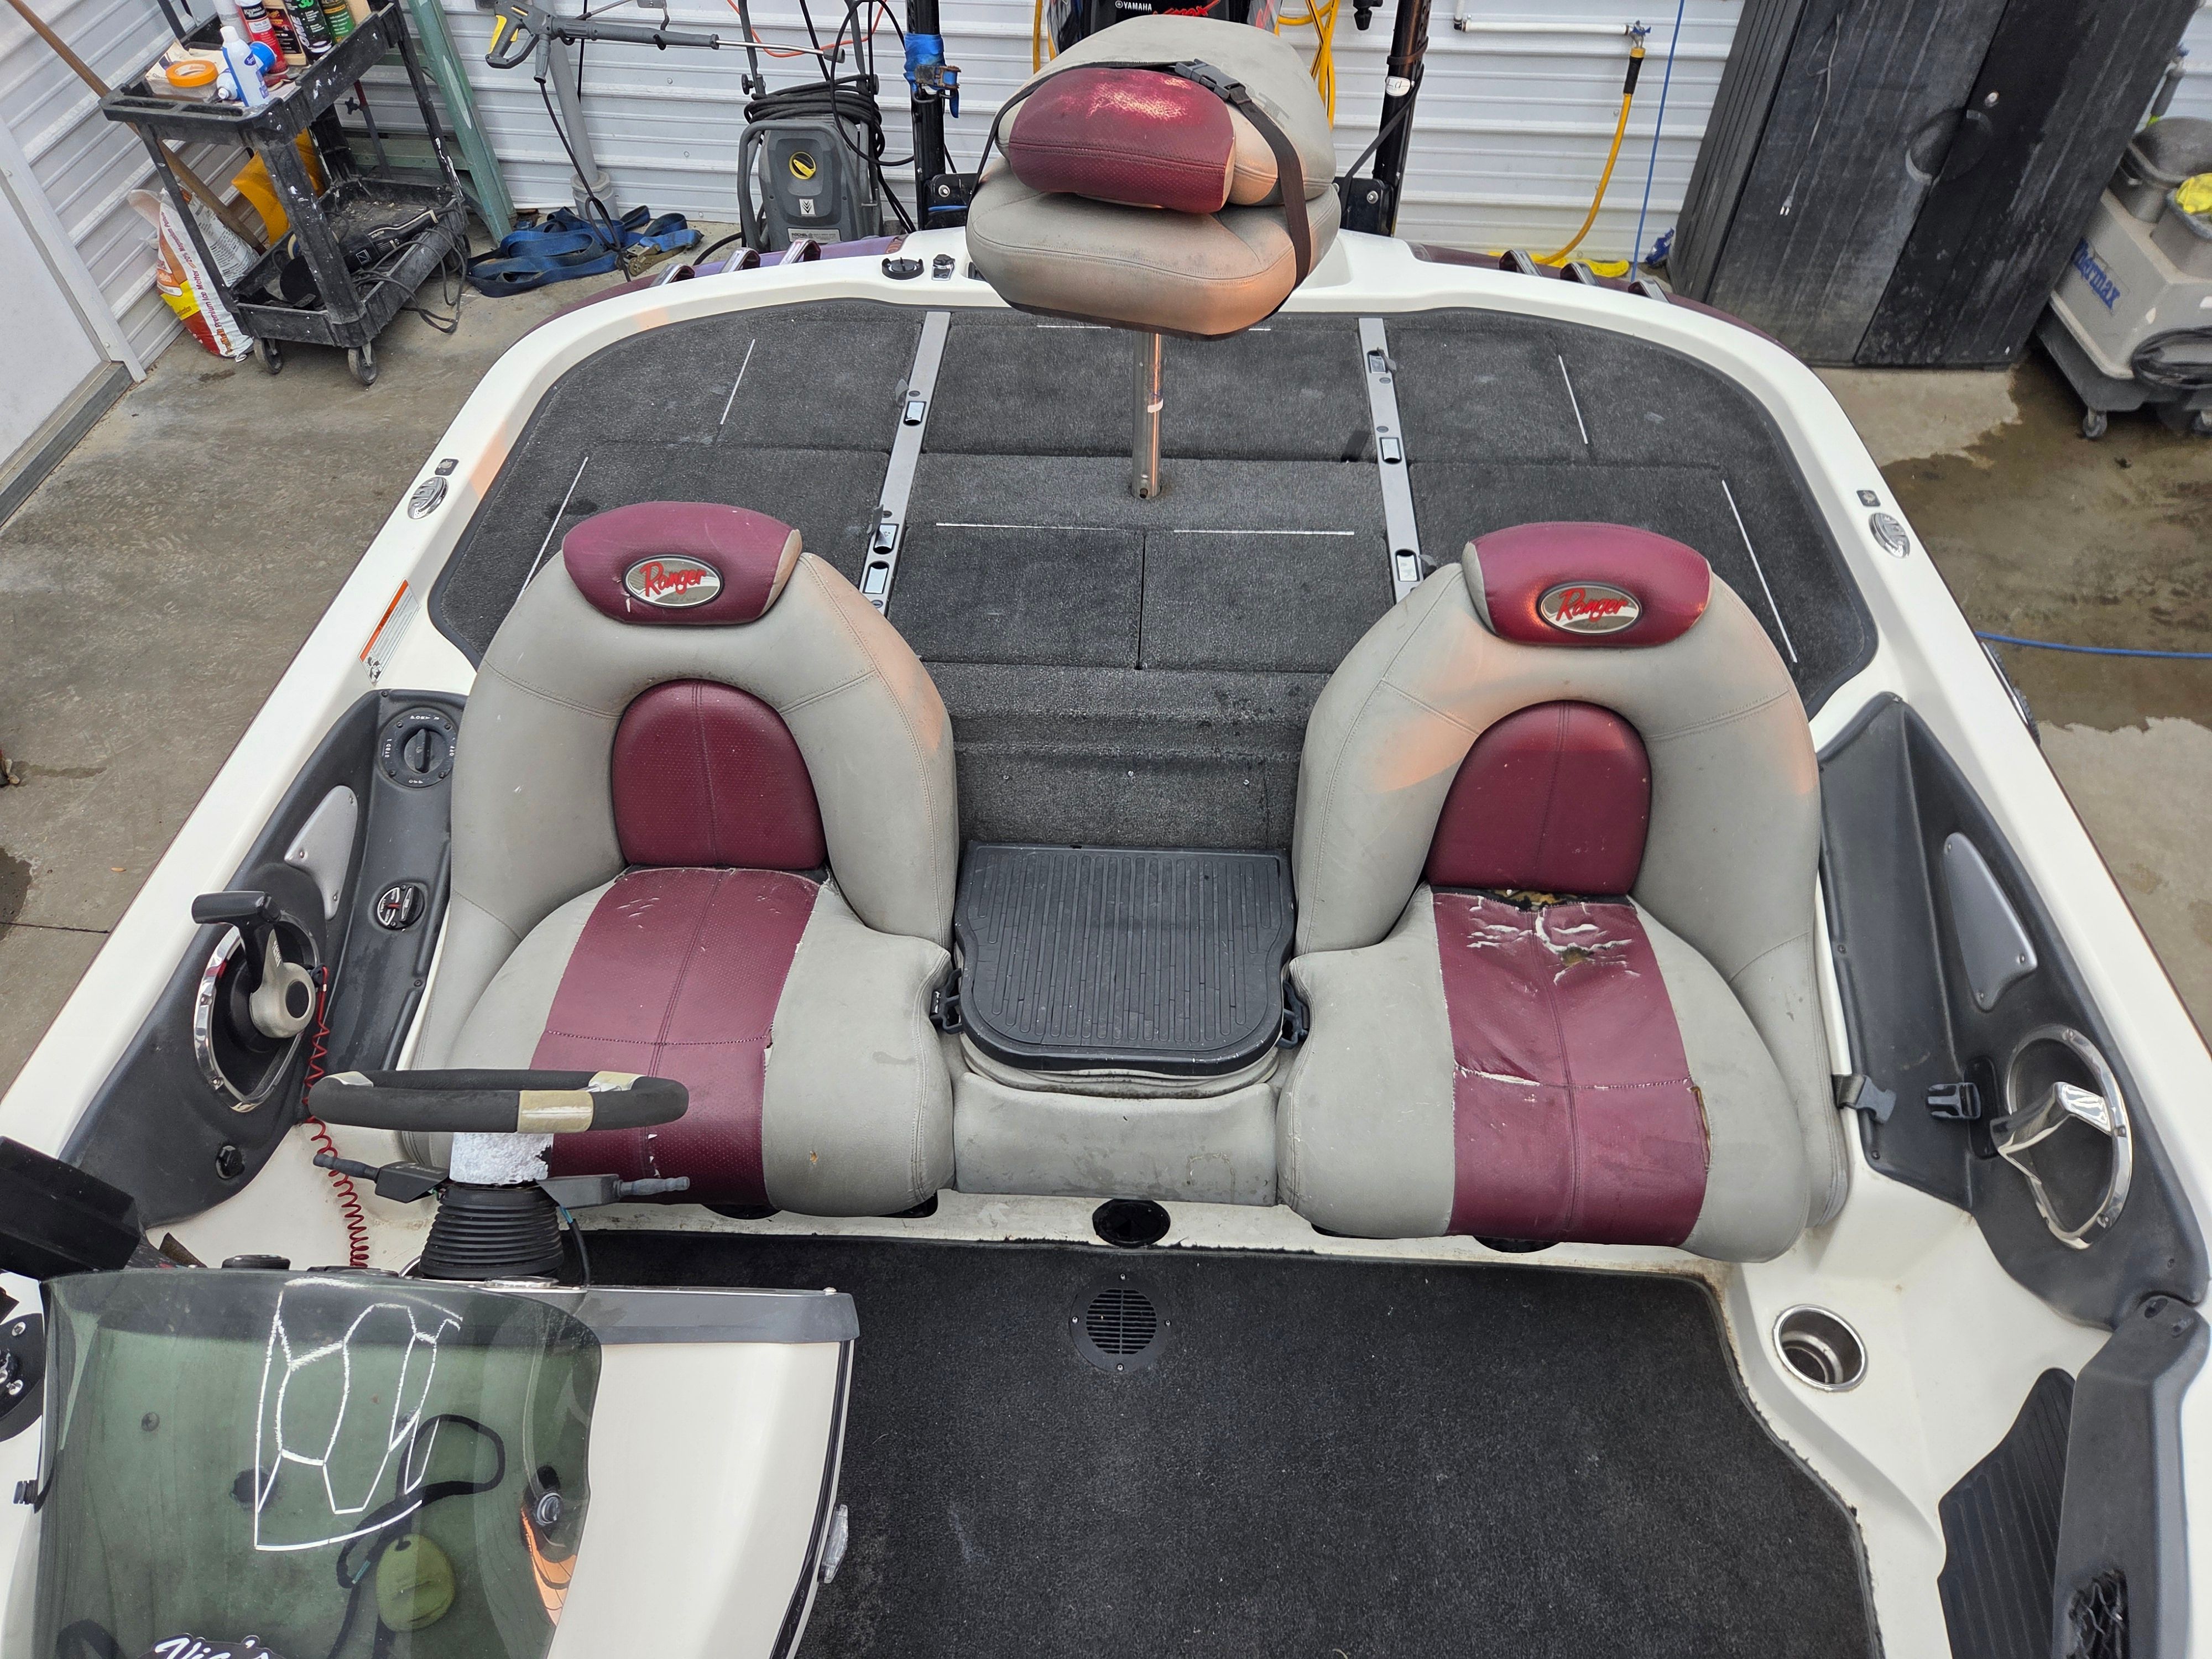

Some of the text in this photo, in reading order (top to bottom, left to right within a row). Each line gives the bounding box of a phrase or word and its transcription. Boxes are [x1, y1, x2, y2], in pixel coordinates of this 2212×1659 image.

[1123, 2, 1152, 12] YAMAHA
[290, 14, 310, 47] ONE
[2073, 237, 2121, 310] hermax
[200, 291, 210, 301] Ice
[206, 302, 222, 328] Premium
[639, 561, 707, 597] Ranger
[1556, 587, 1629, 623] Ranger
